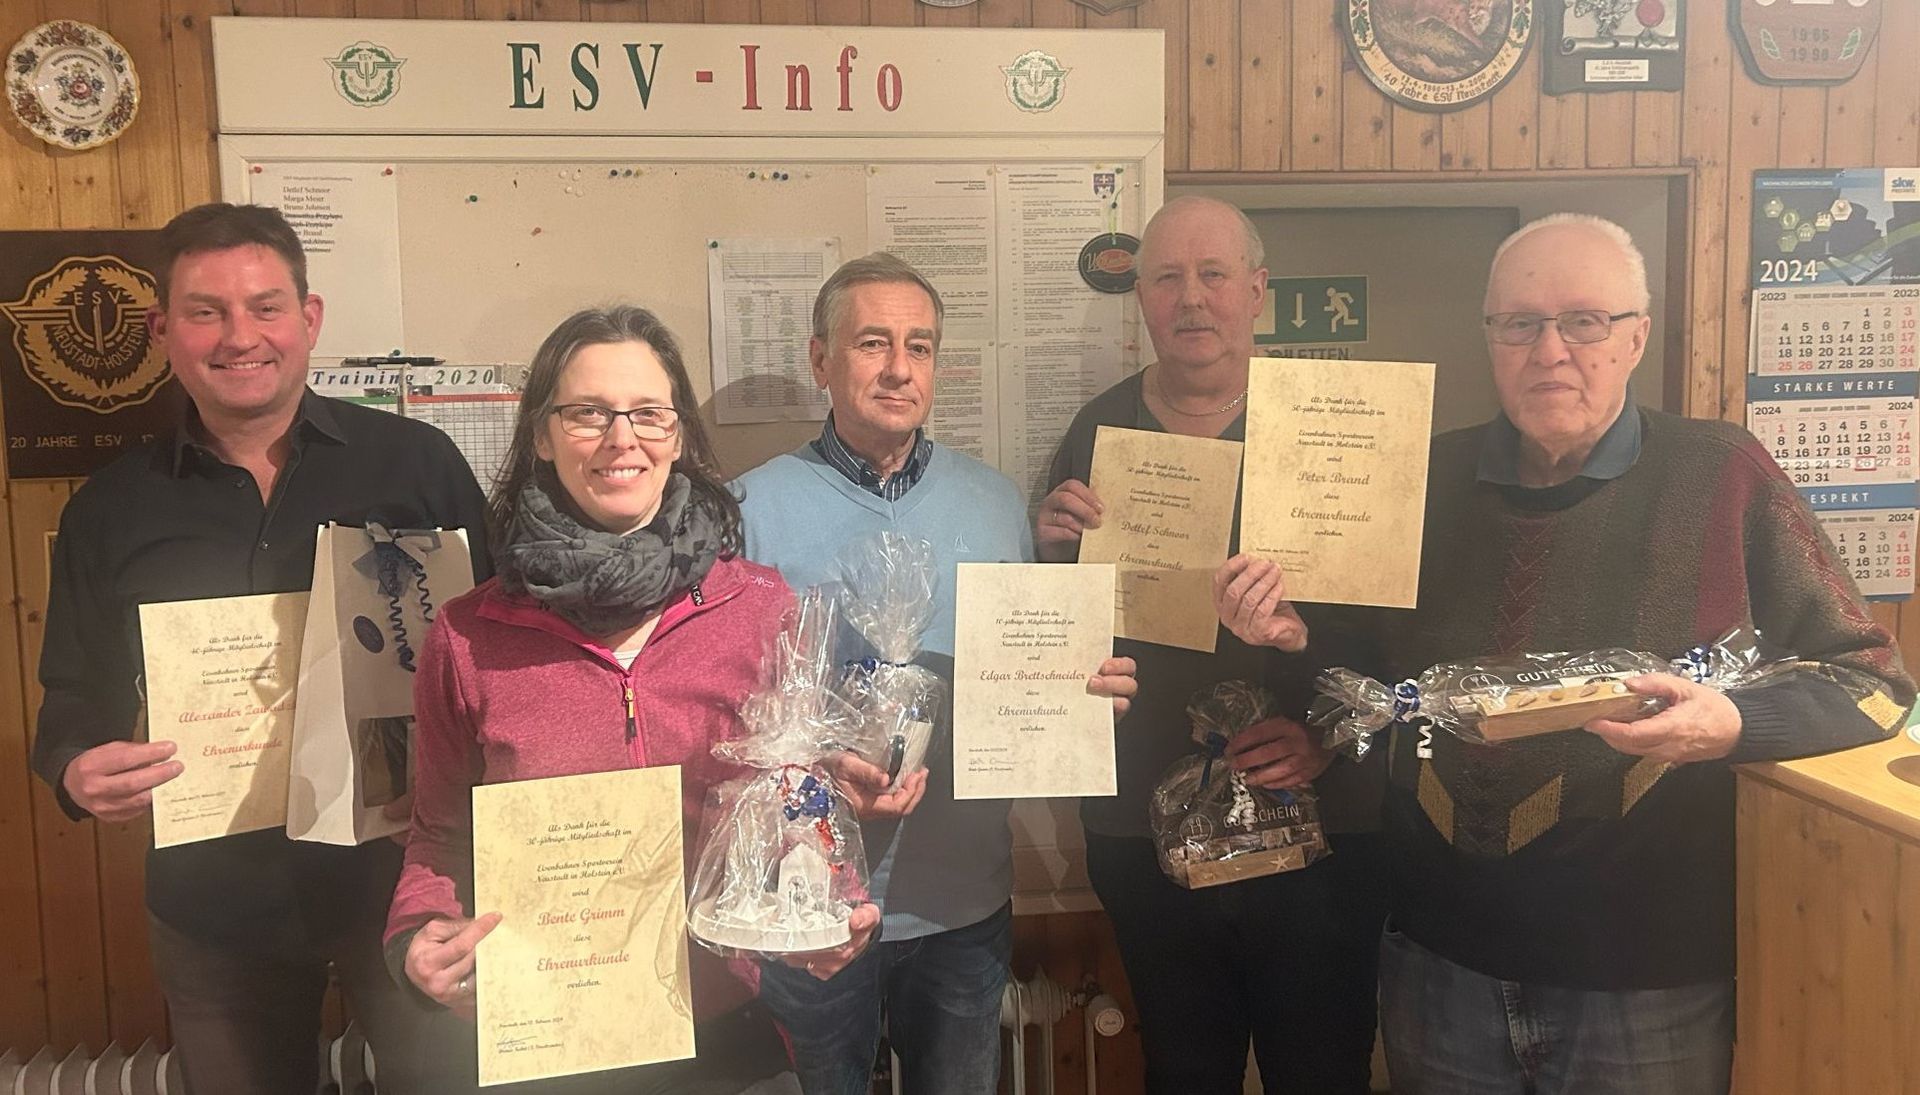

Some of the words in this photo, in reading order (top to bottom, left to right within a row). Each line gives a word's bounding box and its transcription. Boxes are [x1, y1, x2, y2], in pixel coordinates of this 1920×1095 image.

[1383, 73, 1398, 86] 40
[1434, 91, 1452, 102] ESV
[1760, 259, 1818, 282] 2024
[74, 291, 121, 305] ESV
[1761, 293, 1786, 301] 2023
[1893, 289, 1919, 298] 2023
[1864, 308, 1869, 317] 1
[1883, 307, 1891, 316] 2
[1904, 307, 1912, 316] 3
[1781, 323, 1789, 332] 4
[1802, 322, 1809, 332] 5
[1822, 322, 1830, 331] 6
[1843, 321, 1850, 330] 7
[1863, 321, 1870, 330] 8
[1883, 320, 1891, 329] 9
[1901, 319, 1915, 328] 10
[1778, 336, 1792, 345] 11
[1799, 335, 1813, 345] 12
[1819, 335, 1833, 344] 13
[1839, 334, 1853, 343] 14
[1860, 333, 1874, 343] 15
[1901, 332, 1915, 342] 17
[51, 324, 145, 370] NEUSTADT-HOLSTEIN
[1778, 349, 1792, 358] 18
[1798, 348, 1813, 357] 19
[1818, 348, 1833, 357] 20
[1838, 347, 1853, 356] 21
[1858, 346, 1874, 355] 22
[1879, 346, 1894, 355] 23
[1900, 345, 1915, 354] 24
[1778, 362, 1792, 370] 25
[1798, 361, 1813, 370] 26
[1818, 360, 1833, 370] 27
[1838, 360, 1853, 369] 28
[1859, 359, 1874, 368] 29
[1879, 359, 1894, 368] 30
[1899, 358, 1914, 367] 31
[435, 369, 494, 385] 2020
[1774, 382, 1833, 393] STARKE
[1844, 381, 1894, 391] WERTE
[1755, 407, 1781, 415] 2024
[1888, 402, 1913, 410] 2024
[1778, 424, 1785, 433] 1
[1798, 423, 1806, 432] 2
[1819, 422, 1827, 431] 3
[1840, 421, 1847, 430] 4
[1860, 420, 1867, 430] 5
[1880, 420, 1887, 429] 6
[1900, 419, 1907, 428] 7
[10, 438, 26, 448] 20
[35, 436, 78, 448] JAHRE
[95, 435, 122, 447] ESV
[1777, 437, 1785, 446] 8
[1798, 436, 1806, 445] 9
[1816, 435, 1830, 444] 10
[1837, 434, 1850, 443] 11
[1857, 433, 1871, 442] 12
[1877, 432, 1891, 441] 13
[1897, 432, 1910, 441] 14
[1774, 449, 1789, 458] 15
[1795, 449, 1809, 458] 16
[1816, 448, 1830, 457] 17
[1836, 447, 1850, 456] 18
[1857, 446, 1871, 455] 19
[1877, 445, 1891, 454] 20
[1896, 445, 1910, 454] 21
[1795, 461, 1809, 470] 23
[1815, 460, 1830, 469] 24
[1836, 460, 1850, 469] 25
[1876, 458, 1890, 467] 27
[1896, 457, 1911, 466] 28
[1297, 471, 1326, 482] Peter
[1330, 472, 1370, 485] Brand
[1795, 473, 1810, 483] 30
[1815, 473, 1830, 482] 31
[1291, 507, 1371, 522] Ehrenurkunde
[1888, 514, 1914, 522] 2024
[1121, 521, 1151, 535] Detlef
[1839, 533, 1845, 542] 1
[1859, 532, 1866, 541] 2
[1879, 531, 1886, 540] 3
[1899, 531, 1906, 539] 4
[1839, 546, 1846, 555] 8
[1859, 545, 1866, 554] 9
[1876, 544, 1890, 553] 10
[1896, 544, 1909, 552] 11
[1843, 558, 1849, 567] 5
[1856, 558, 1870, 566] 16
[1876, 557, 1889, 565] 17
[1896, 556, 1910, 565] 18
[1855, 570, 1870, 579] 23
[1876, 569, 1890, 578] 24
[1896, 568, 1910, 577] 25
[980, 670, 1011, 681] Edgar
[1014, 670, 1086, 680] Brettschneider
[179, 708, 241, 723] Alexander
[998, 705, 1068, 716] Ehrenurkunde
[202, 738, 283, 757] Ehrenurkunde
[537, 911, 576, 926] Bente
[580, 907, 625, 925] Grimm
[537, 949, 629, 971] Ehrenurkunde
